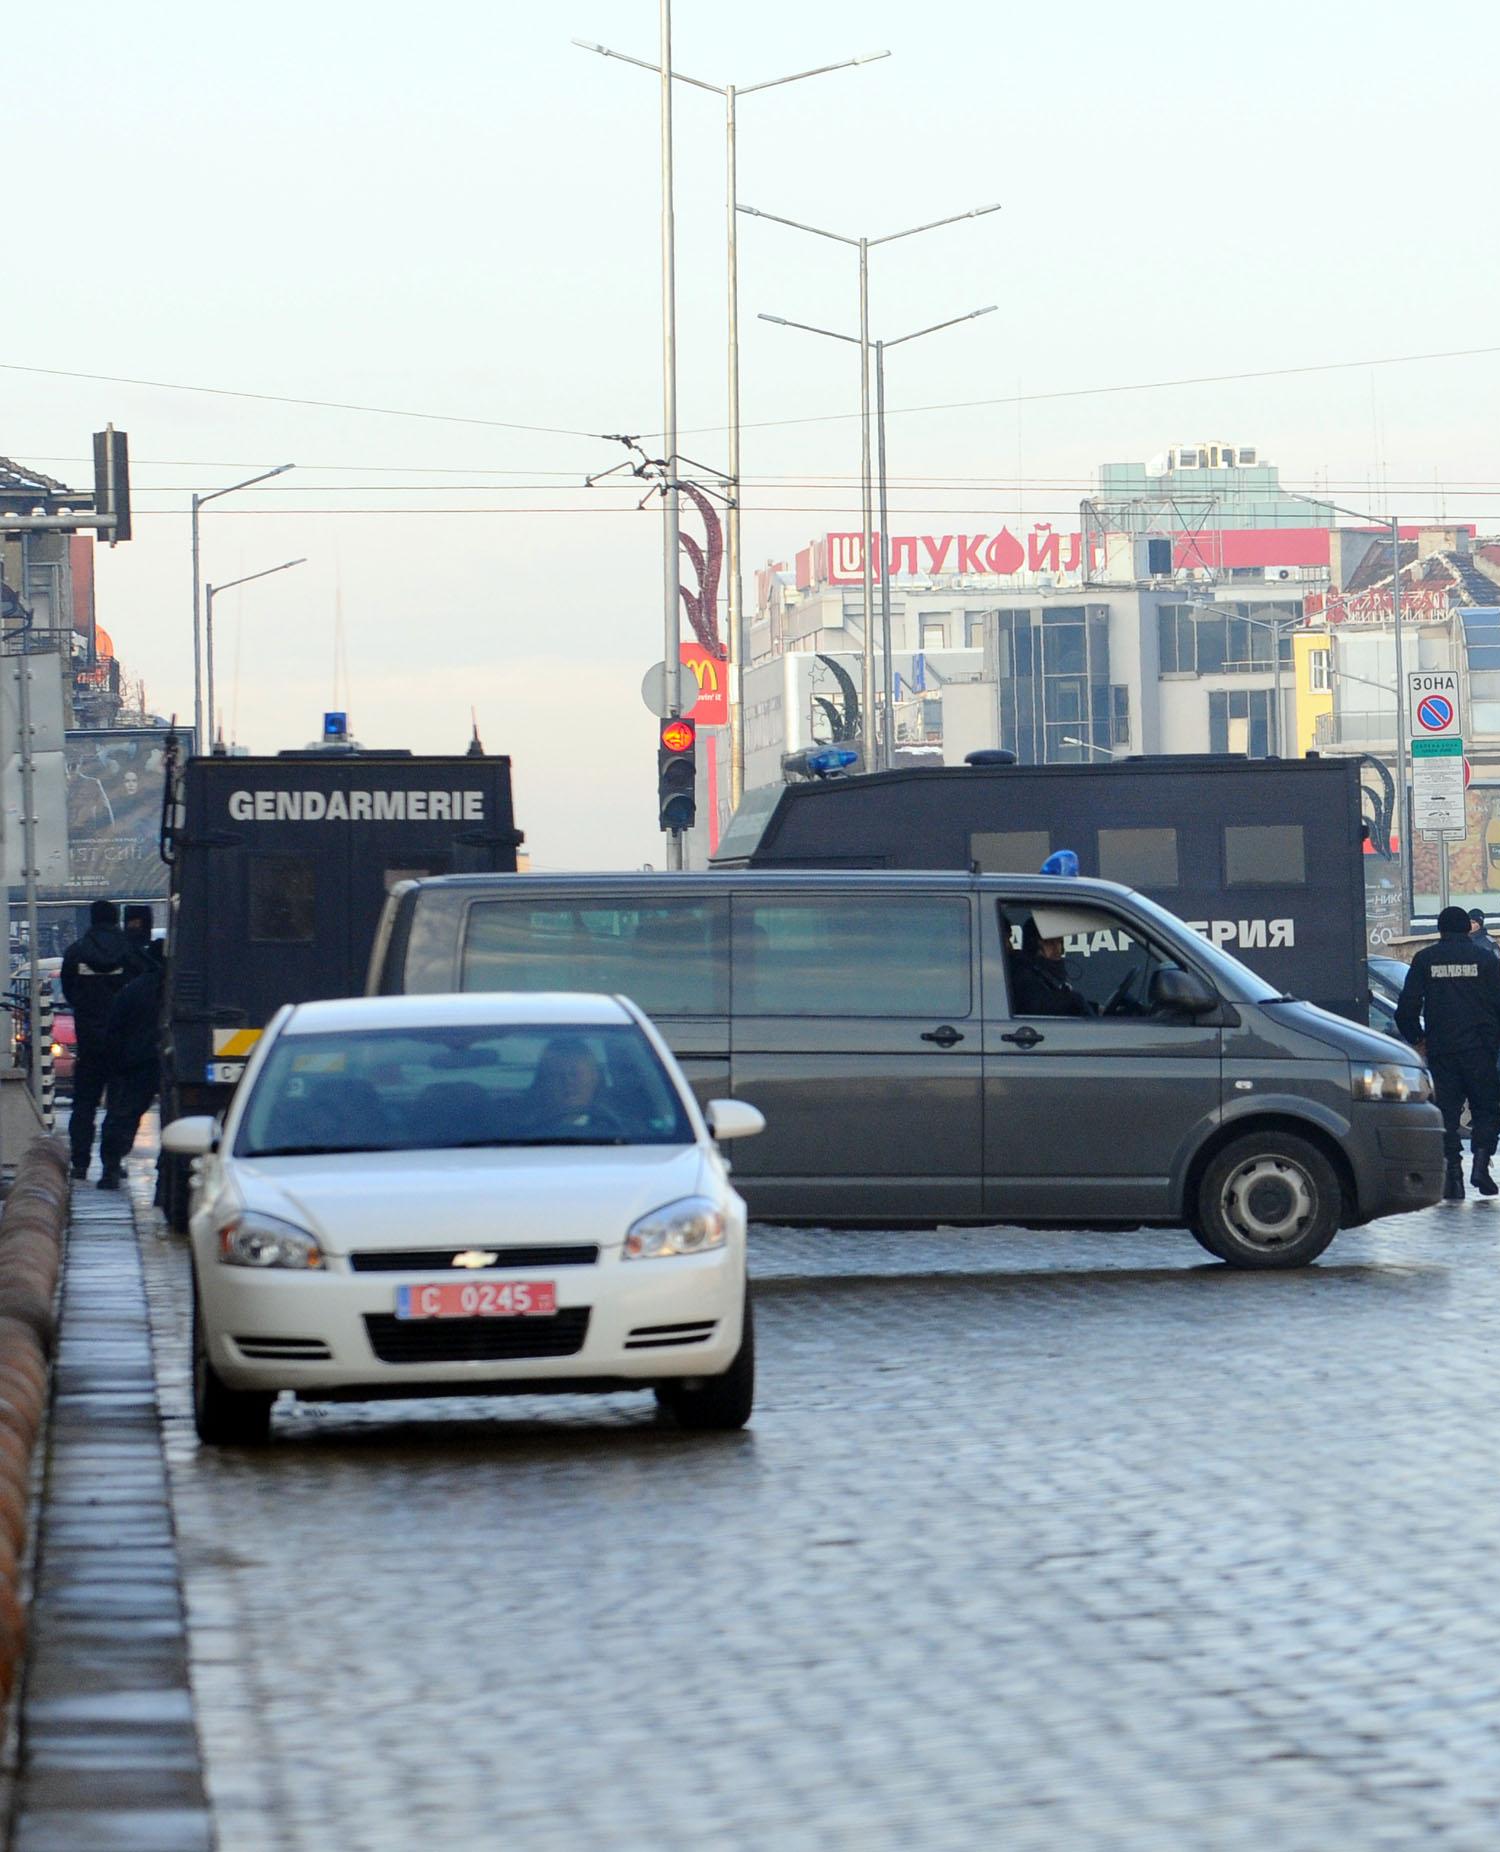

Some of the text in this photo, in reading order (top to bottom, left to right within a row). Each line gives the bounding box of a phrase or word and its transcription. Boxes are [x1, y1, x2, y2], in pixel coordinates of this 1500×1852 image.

[1413, 677, 1455, 690] ЗОНА
[228, 790, 484, 821] GENDARMERIE
[421, 1287, 441, 1313] C
[460, 1285, 532, 1313] 0245
